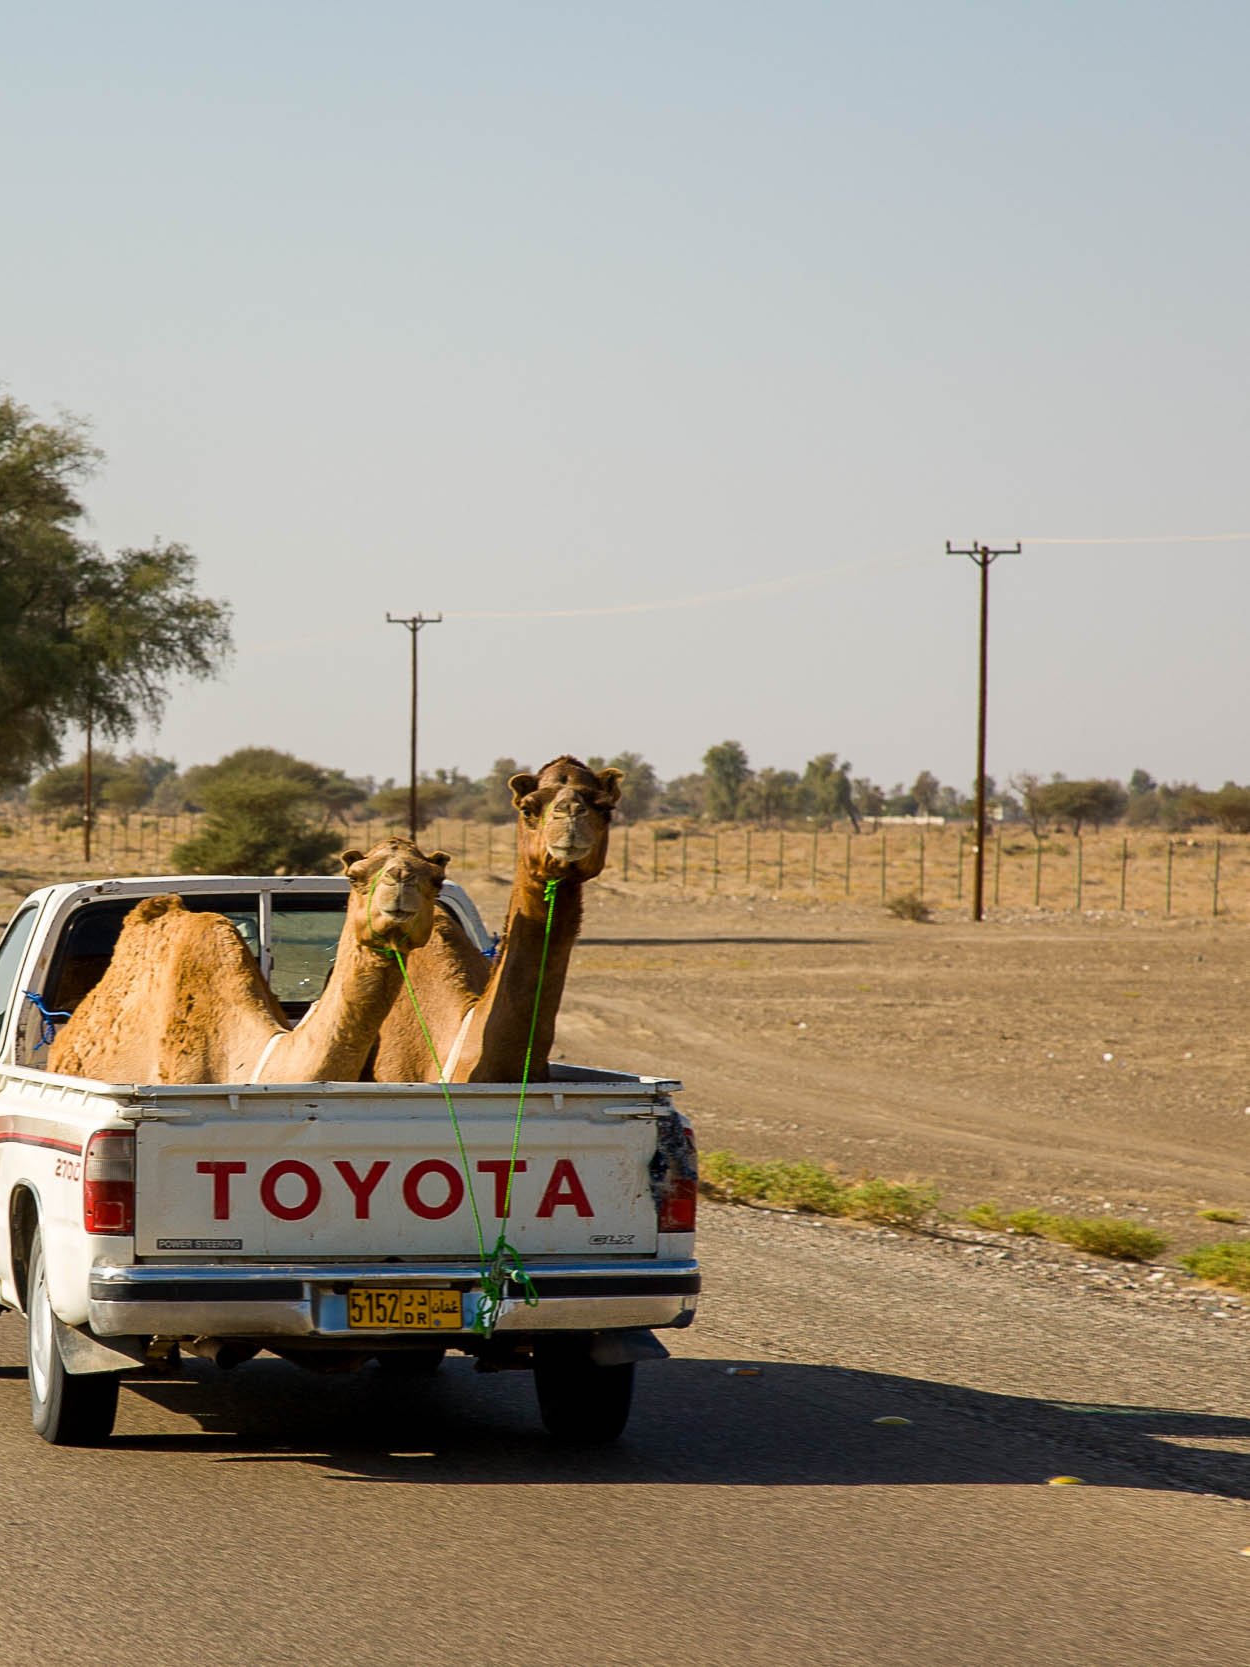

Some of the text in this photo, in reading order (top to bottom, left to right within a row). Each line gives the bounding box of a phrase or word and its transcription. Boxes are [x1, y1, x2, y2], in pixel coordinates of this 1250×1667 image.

[196, 1159, 594, 1220] TOYOTA
[158, 1240, 240, 1249] POWER STEERING
[589, 1234, 636, 1245] GLX
[351, 1293, 400, 1323] 5152
